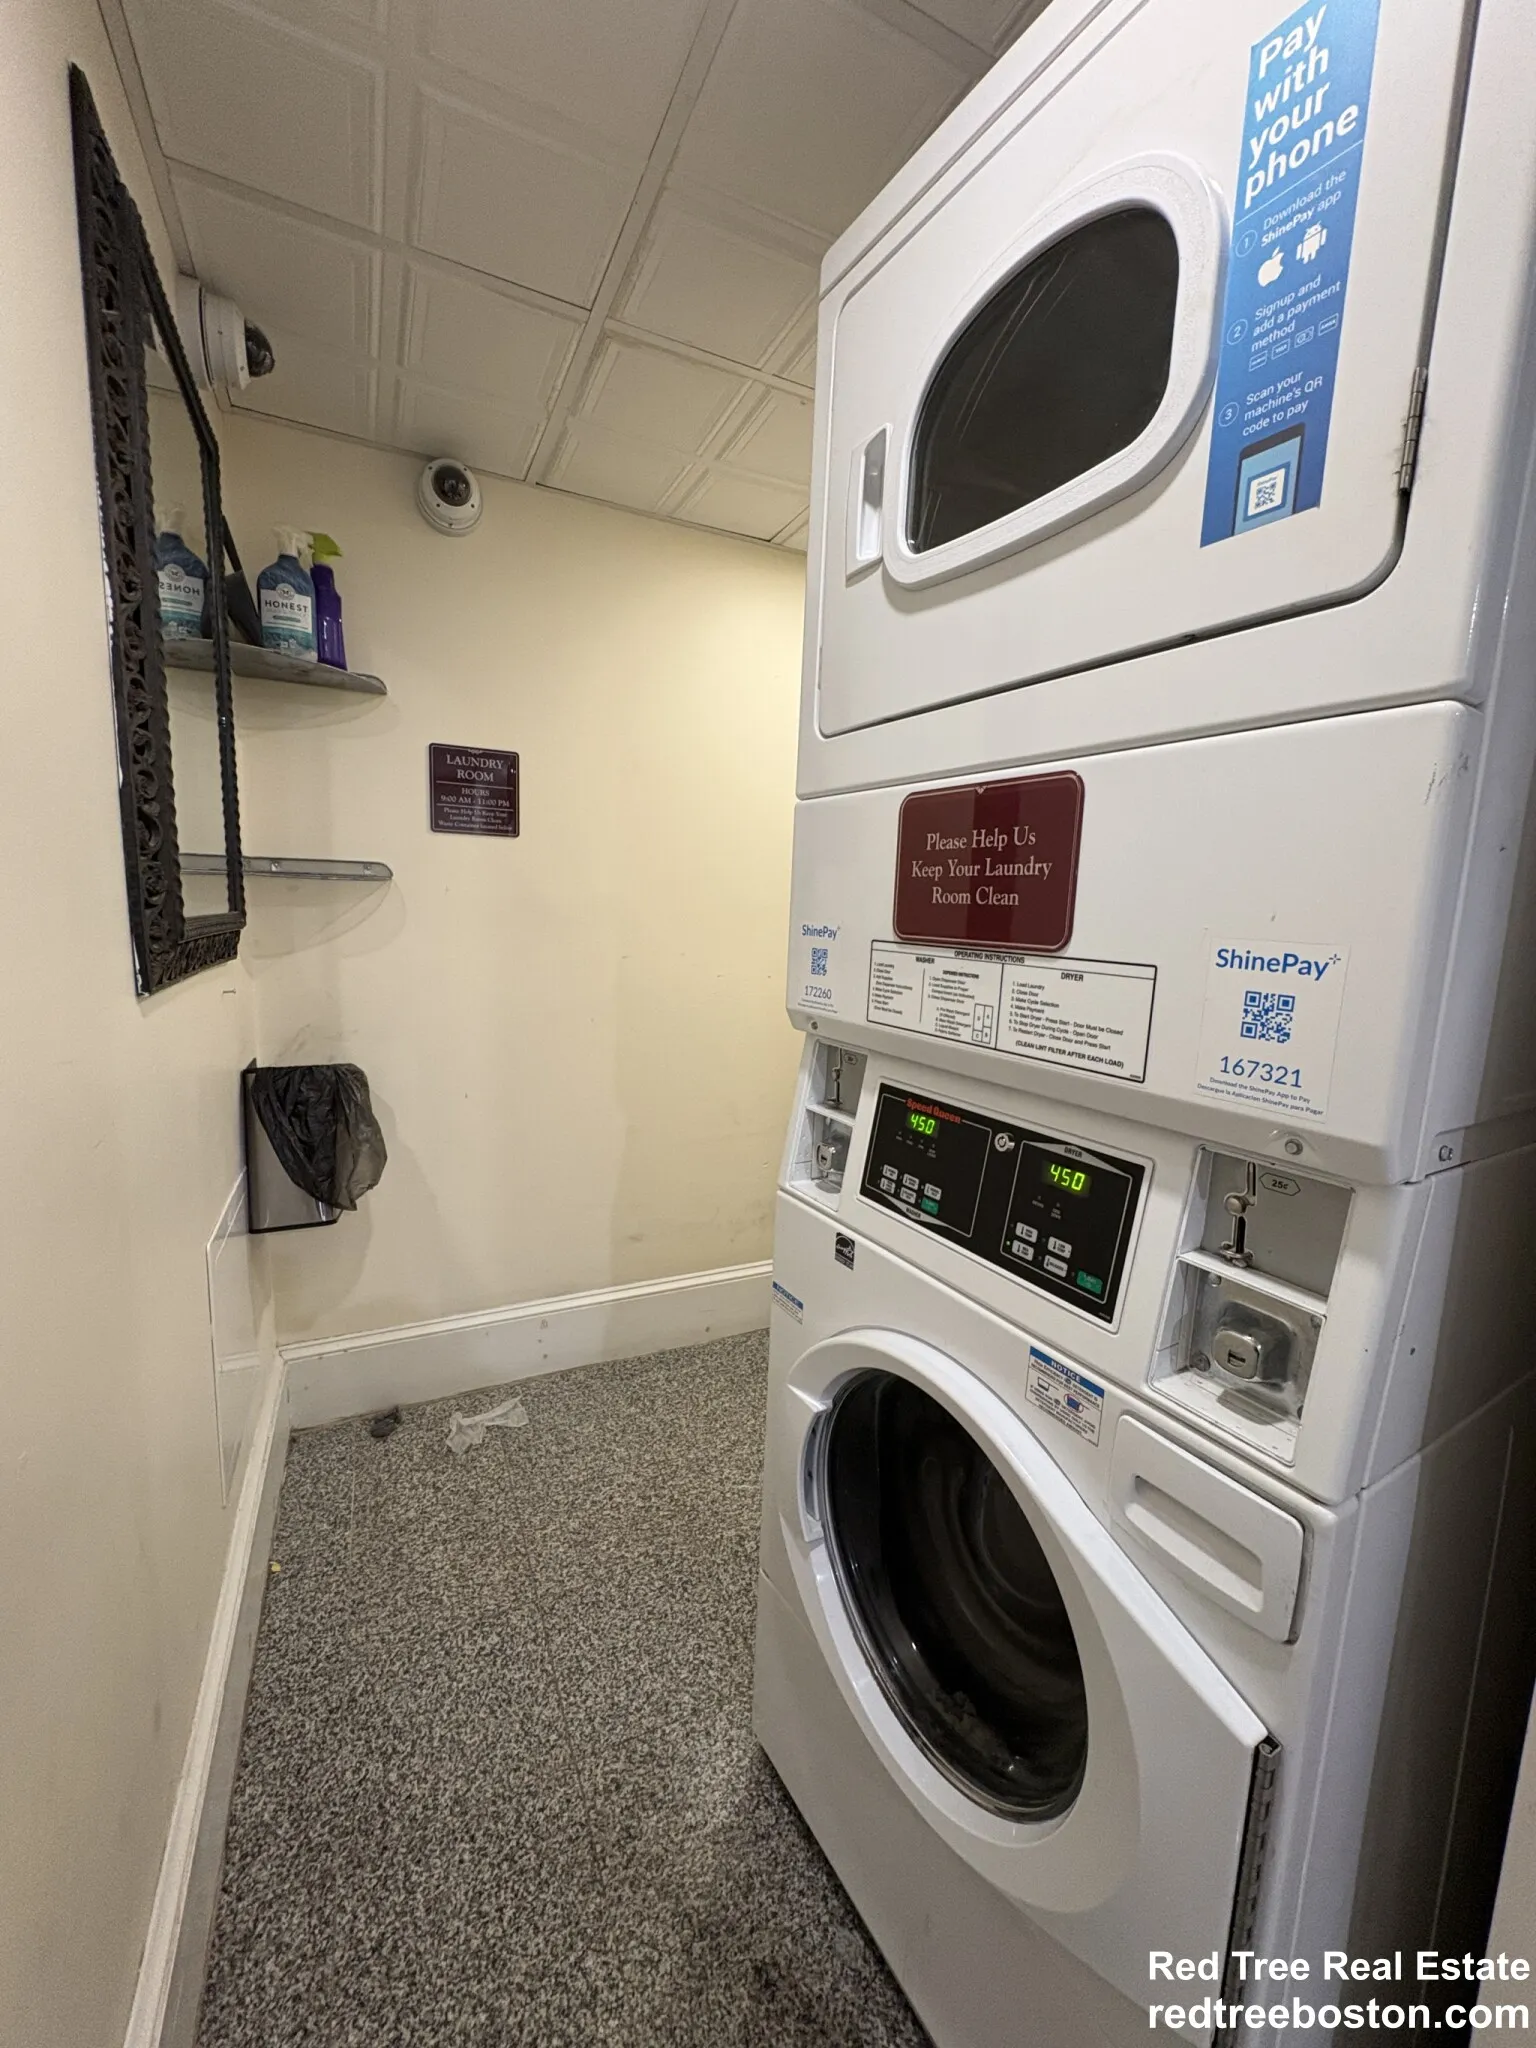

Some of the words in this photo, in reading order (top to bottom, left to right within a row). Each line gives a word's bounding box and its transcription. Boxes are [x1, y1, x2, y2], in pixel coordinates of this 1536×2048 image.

[1258, 4, 1327, 80] Pay
[1254, 46, 1329, 122] with
[1249, 82, 1330, 170] your
[1244, 104, 1359, 209] phone
[1263, 183, 1322, 230] Download
[1326, 171, 1346, 190] the
[1260, 207, 1315, 247] ShinePay
[1317, 190, 1342, 212] app
[1253, 316, 1274, 336] add
[1277, 314, 1284, 323] a
[1287, 281, 1341, 320] payment
[1255, 292, 1296, 320] Signup
[1298, 274, 1321, 296] and
[1233, 326, 1241, 338] 2
[1251, 320, 1296, 352] method
[1244, 387, 1302, 421] machine's
[1304, 376, 1322, 393] QR
[1246, 386, 1274, 405] Scan
[1277, 371, 1303, 394] your
[1225, 408, 1232, 420] 3
[1242, 418, 1270, 436] code
[1272, 412, 1284, 423] to
[1287, 400, 1309, 420] pay
[265, 600, 308, 613] HONEST
[446, 754, 504, 770] LAUNDRY
[457, 769, 494, 782] ROOM
[440, 794, 456, 802] 9:00
[462, 787, 490, 796] HOURS
[926, 833, 967, 850] Please
[972, 828, 1008, 851] Help
[1013, 826, 1036, 846] Us
[912, 860, 943, 881] Keep
[948, 859, 980, 877] Your
[985, 856, 1053, 880] Laundry
[932, 886, 971, 904] Room
[976, 886, 1020, 906] Clean
[802, 924, 837, 940] ShinePay
[954, 950, 984, 960] OPERATING
[984, 951, 1025, 964] INSTRUCTIONS
[1216, 948, 1330, 981] ShinePay
[1028, 983, 1045, 991] Laundry
[1061, 972, 1084, 982] DRYER
[804, 985, 832, 1000] 172260
[1016, 1040, 1034, 1049] (CLEAN
[1048, 1047, 1066, 1056] FILTER
[1067, 1051, 1086, 1060] AFTER
[1087, 1055, 1104, 1063] EACH
[1104, 1058, 1124, 1069] LOAD)
[1220, 1056, 1302, 1088] 167321
[1210, 1077, 1237, 1088] Download
[1249, 1086, 1275, 1096] ShinePay
[1276, 1092, 1290, 1100] App
[1298, 1096, 1310, 1104] Pay
[906, 1098, 933, 1114] Speed
[933, 1106, 961, 1124] Queen
[911, 1114, 935, 1134] 450
[1050, 1164, 1086, 1191] 450
[1051, 1360, 1080, 1382] NOTICE
